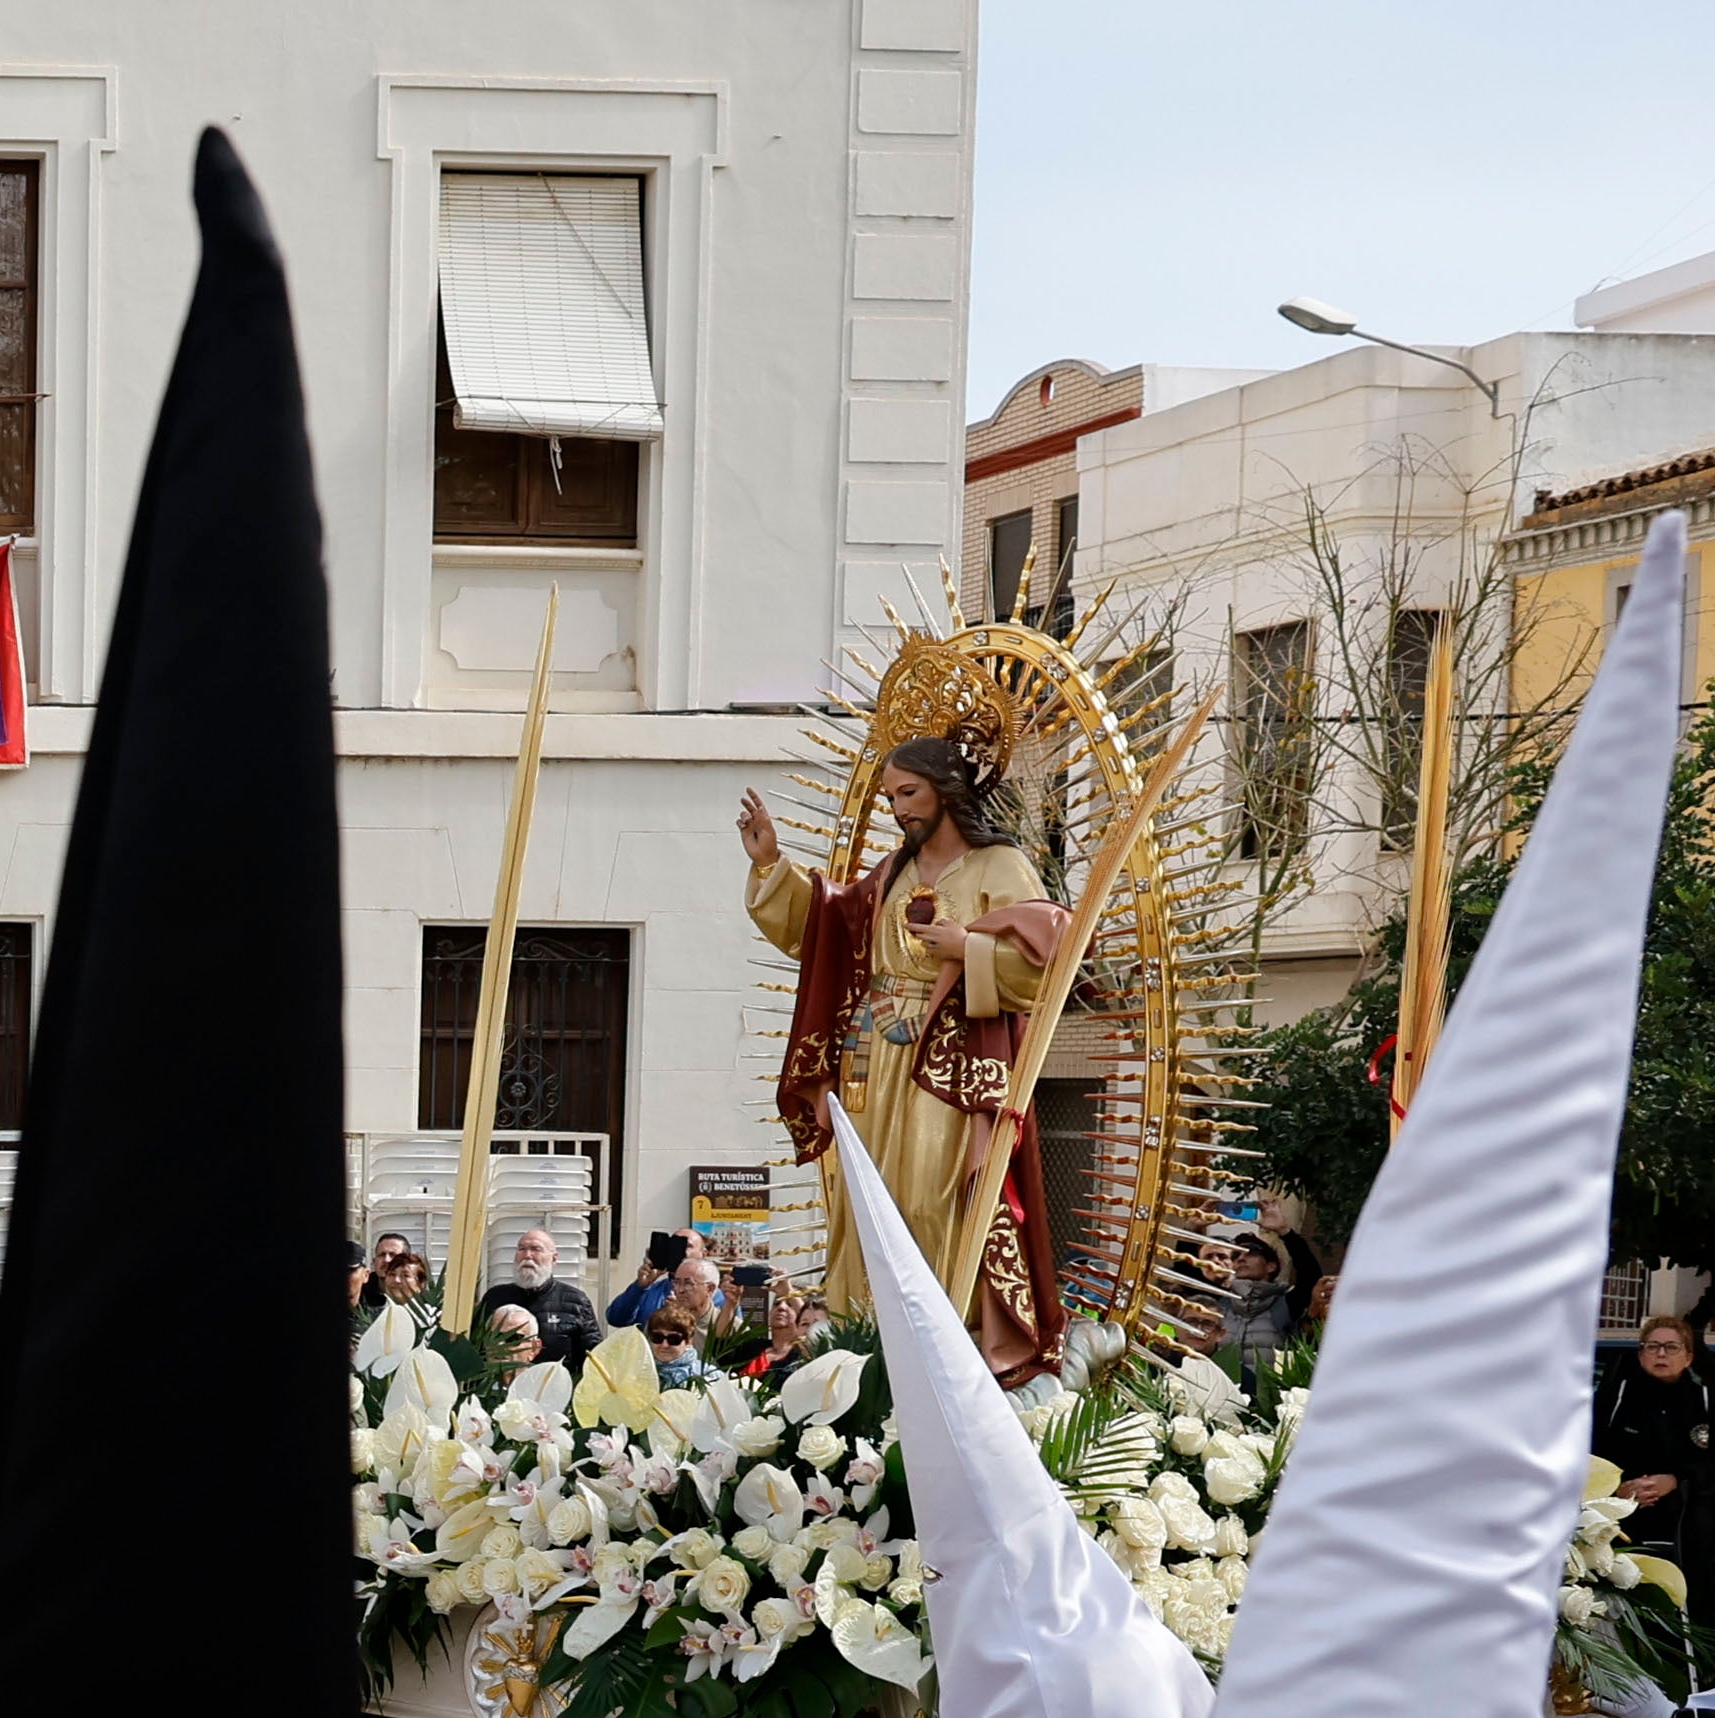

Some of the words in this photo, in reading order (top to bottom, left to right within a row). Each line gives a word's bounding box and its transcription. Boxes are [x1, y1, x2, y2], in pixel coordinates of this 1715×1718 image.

[698, 1173, 720, 1181] RUTA
[721, 1171, 764, 1181] TURÍSTICA
[697, 1200, 704, 1210] 7
